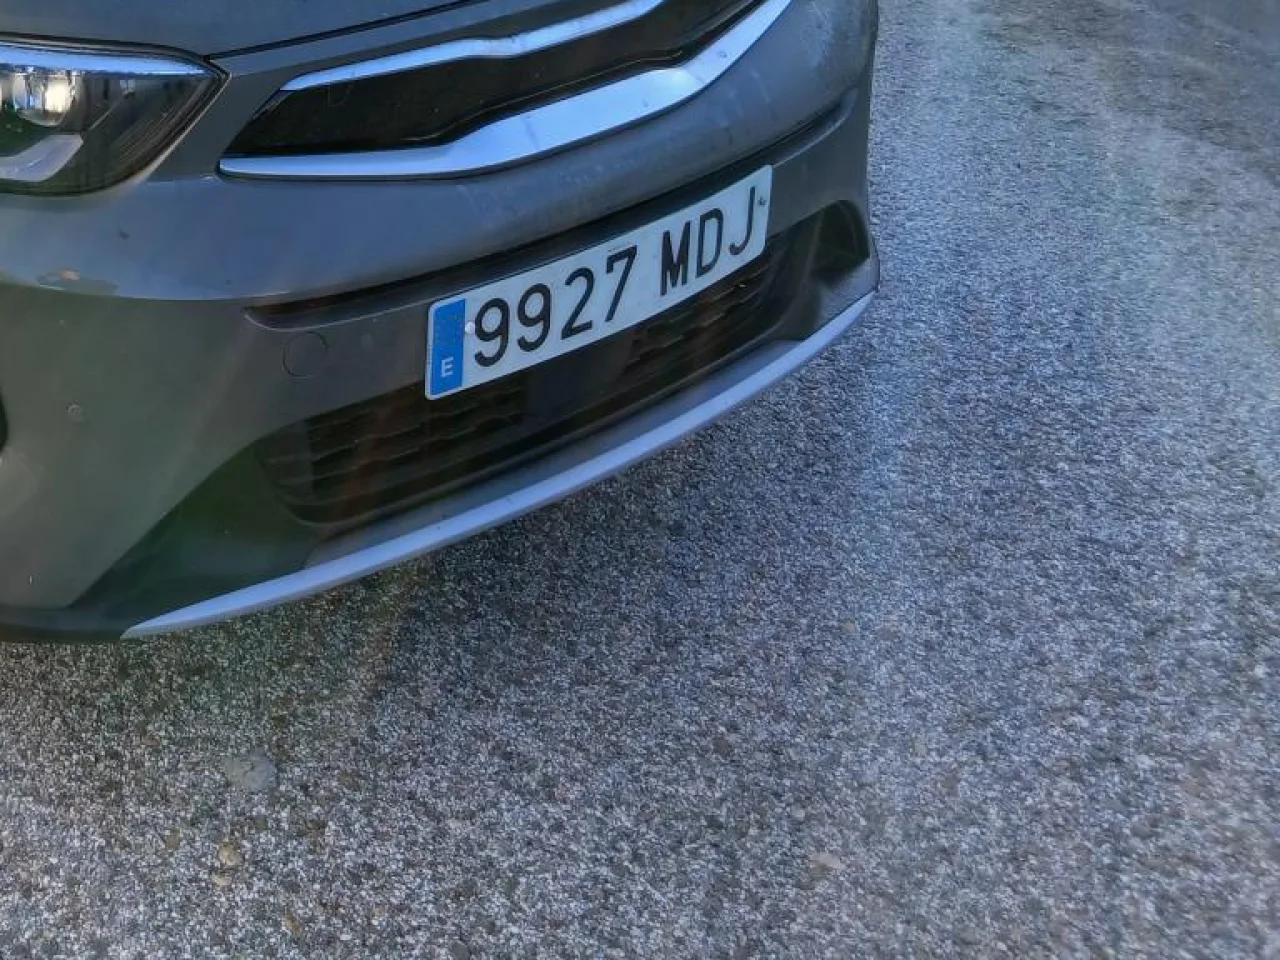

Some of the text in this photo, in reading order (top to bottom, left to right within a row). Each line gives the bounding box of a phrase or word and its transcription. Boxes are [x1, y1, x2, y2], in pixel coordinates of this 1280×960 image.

[474, 186, 756, 368] 9927 MDJ
[441, 356, 454, 377] E
